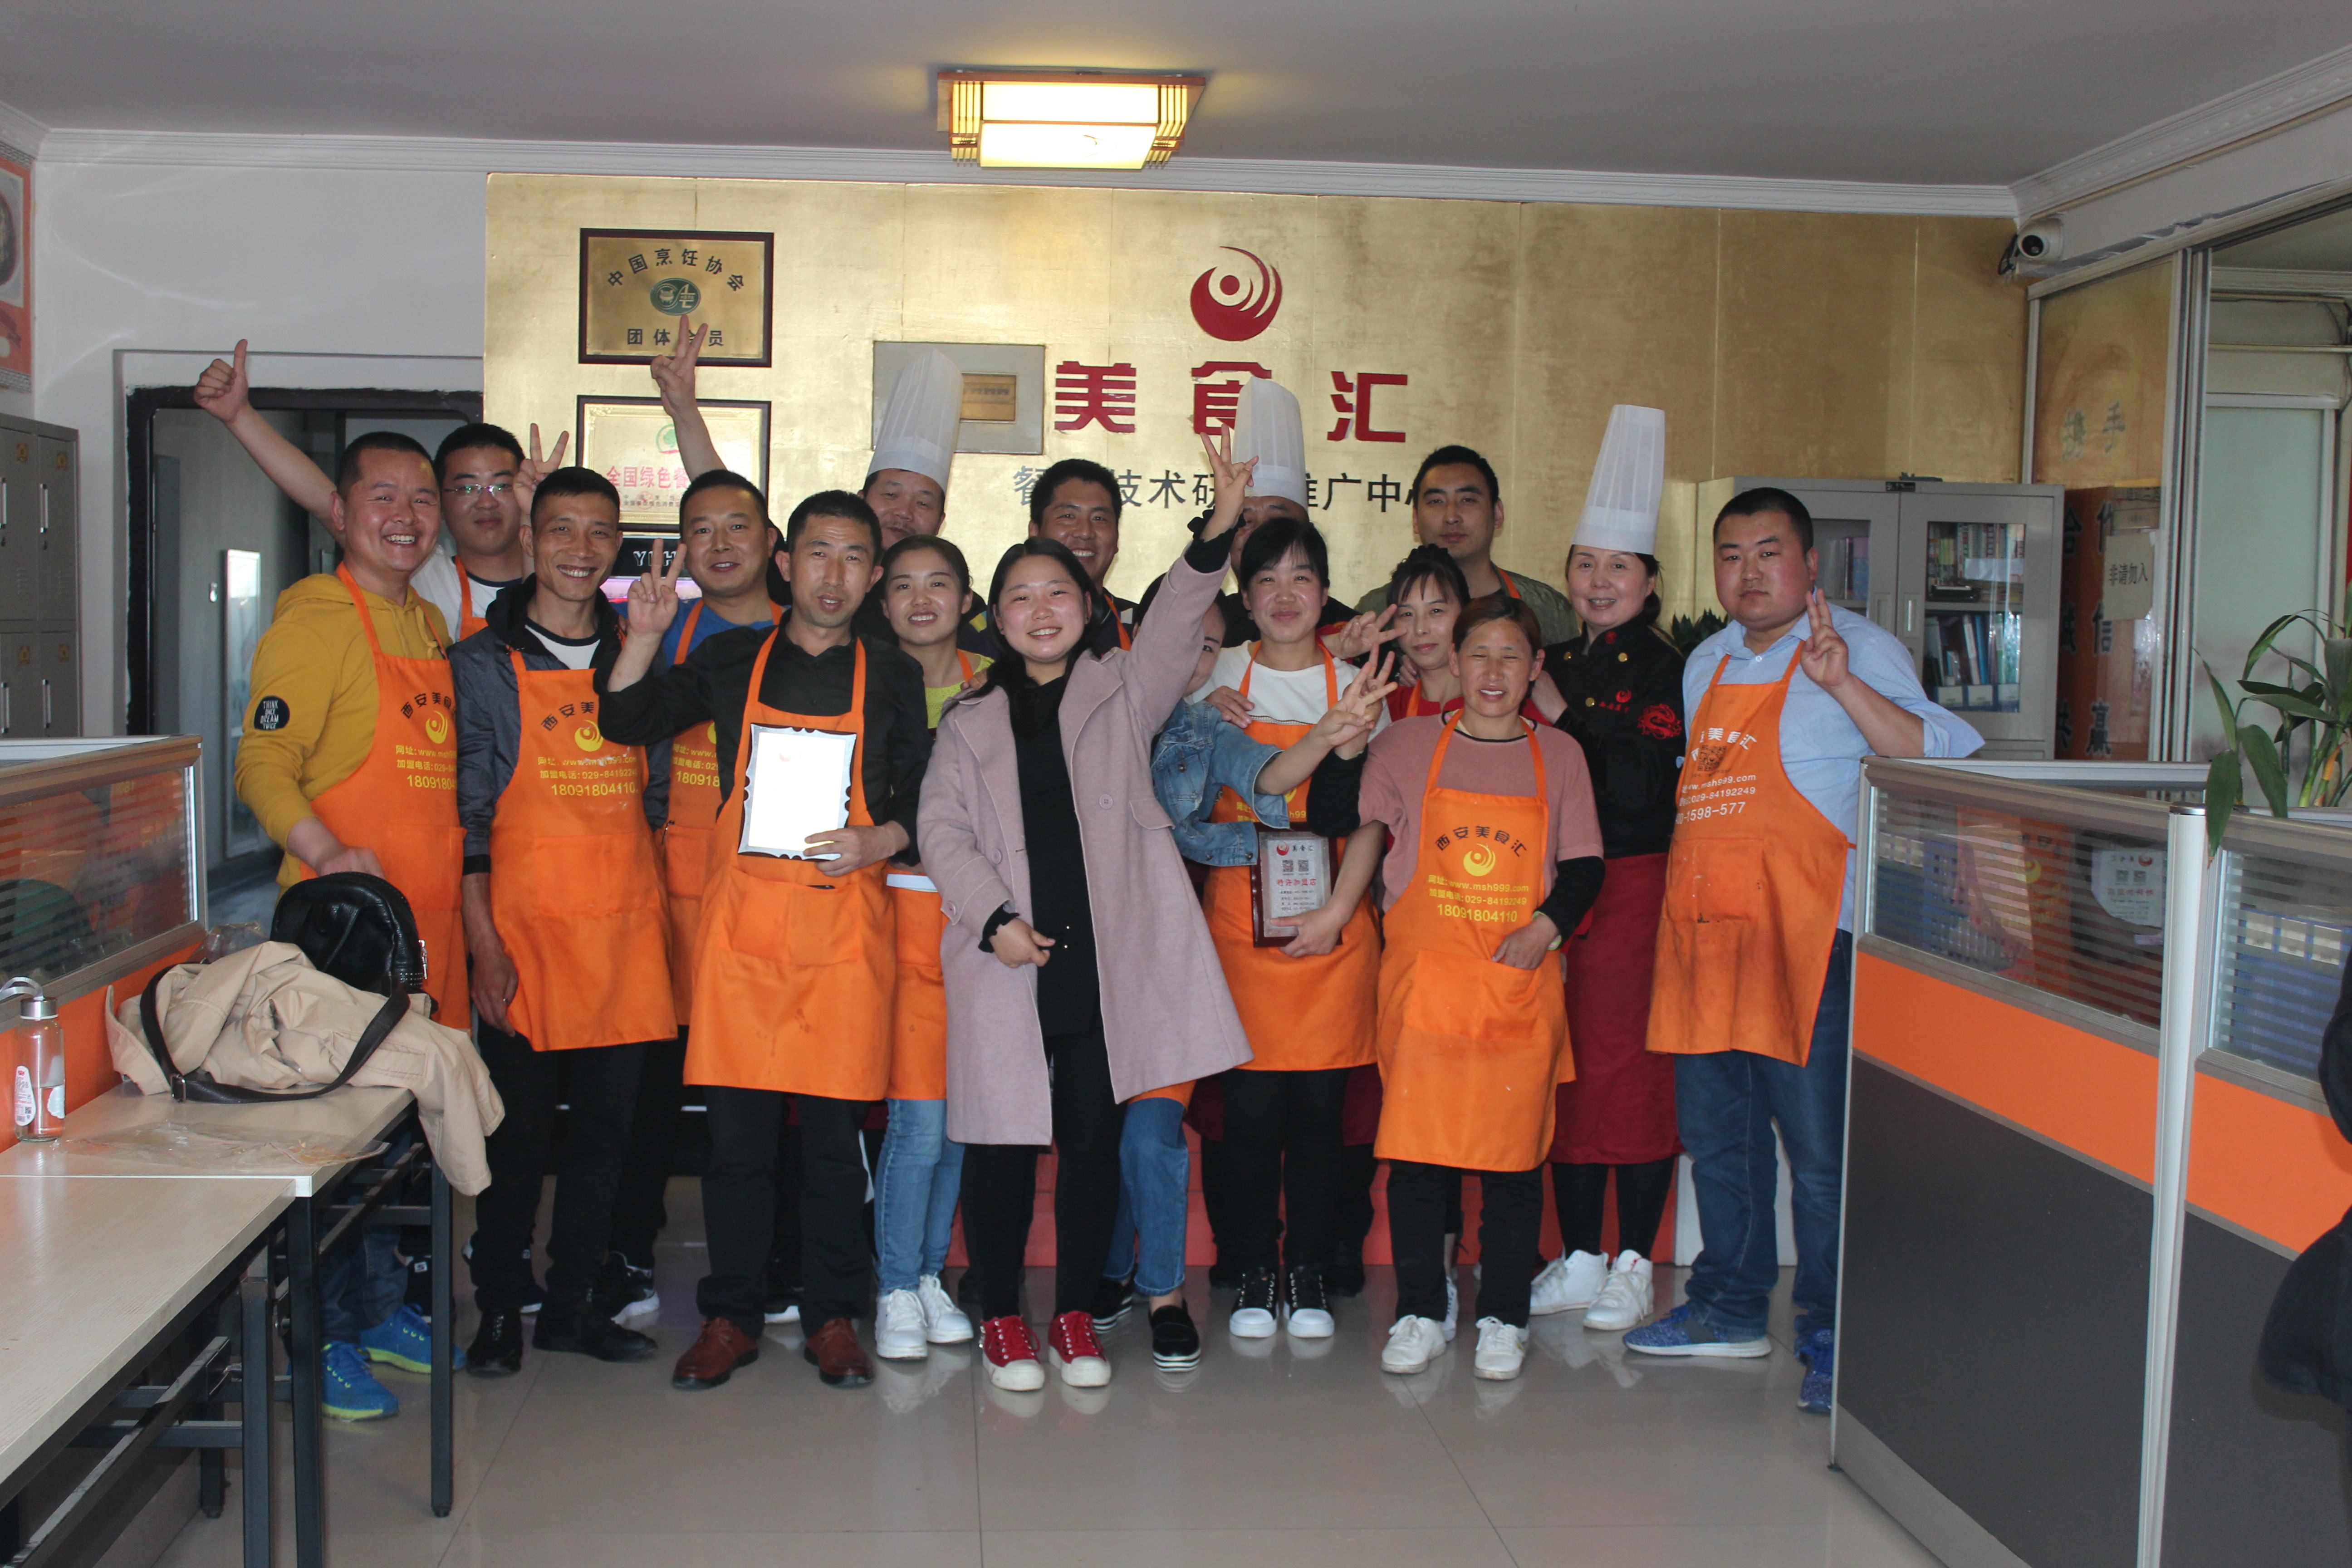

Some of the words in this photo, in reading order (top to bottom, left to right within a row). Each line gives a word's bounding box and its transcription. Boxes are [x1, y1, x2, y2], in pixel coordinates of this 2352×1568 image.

[608, 249, 745, 291] 中国烹饪协会
[1055, 361, 1407, 442] 美食汇
[260, 715, 279, 724] DREAM
[676, 771, 720, 787] 180918
[1435, 825, 1527, 857] 西安美食汇
[1437, 903, 1518, 923] 18091804110
